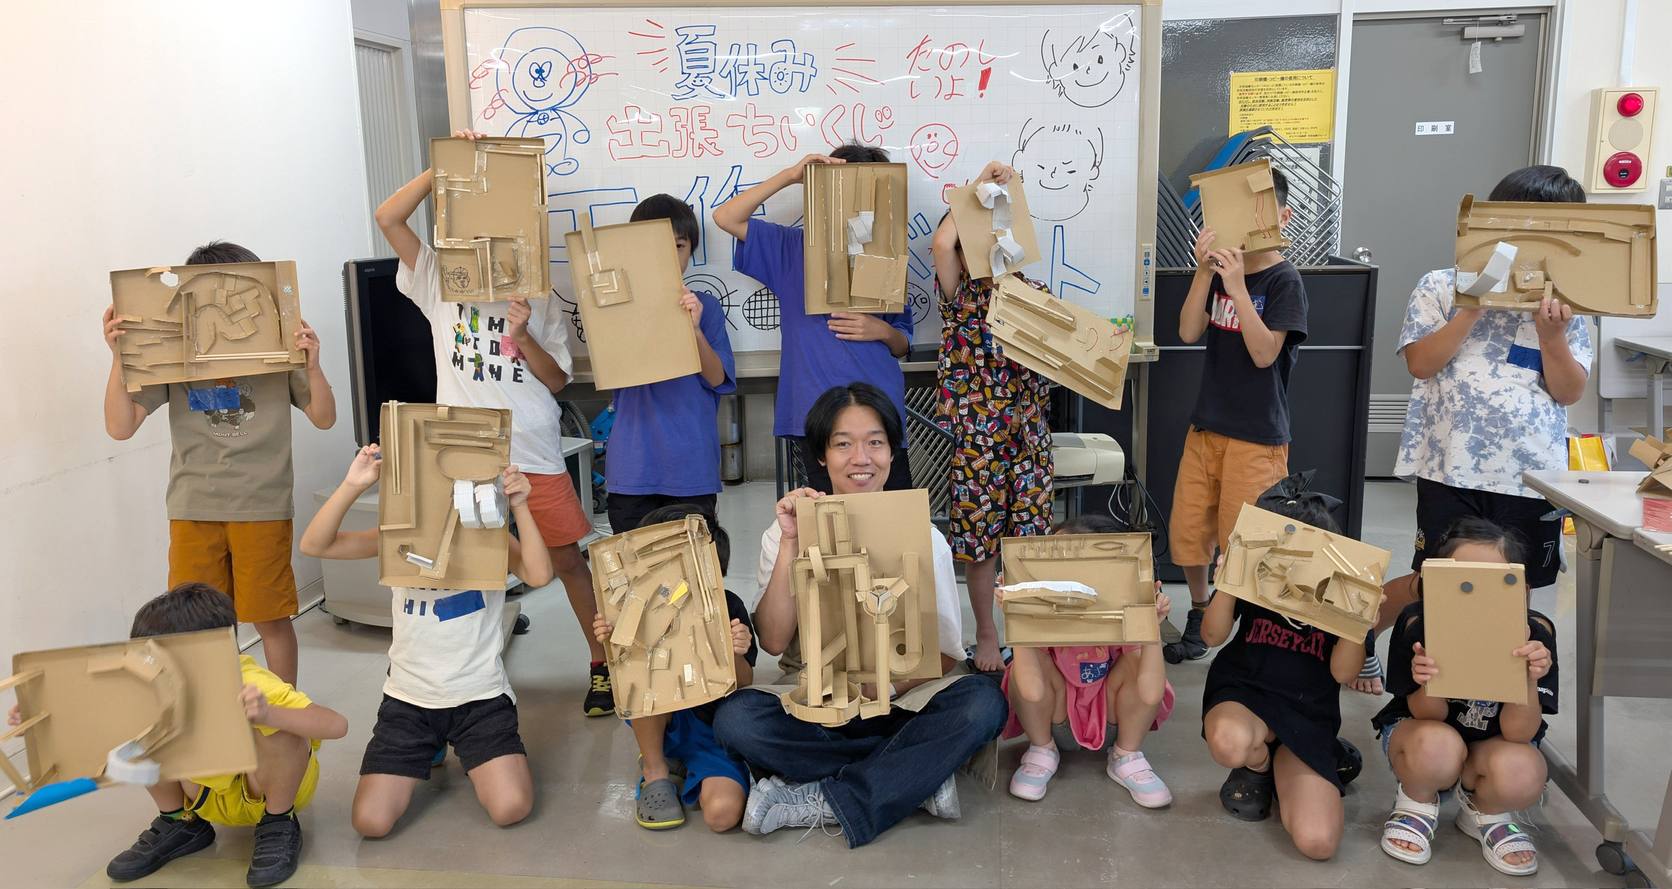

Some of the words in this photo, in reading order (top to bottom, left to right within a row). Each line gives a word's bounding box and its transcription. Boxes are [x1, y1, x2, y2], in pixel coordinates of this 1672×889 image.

[671, 25, 818, 101] 夏休み
[906, 35, 997, 70] たのし
[1416, 124, 1452, 133] 印刷室
[1543, 541, 1555, 567] 7
